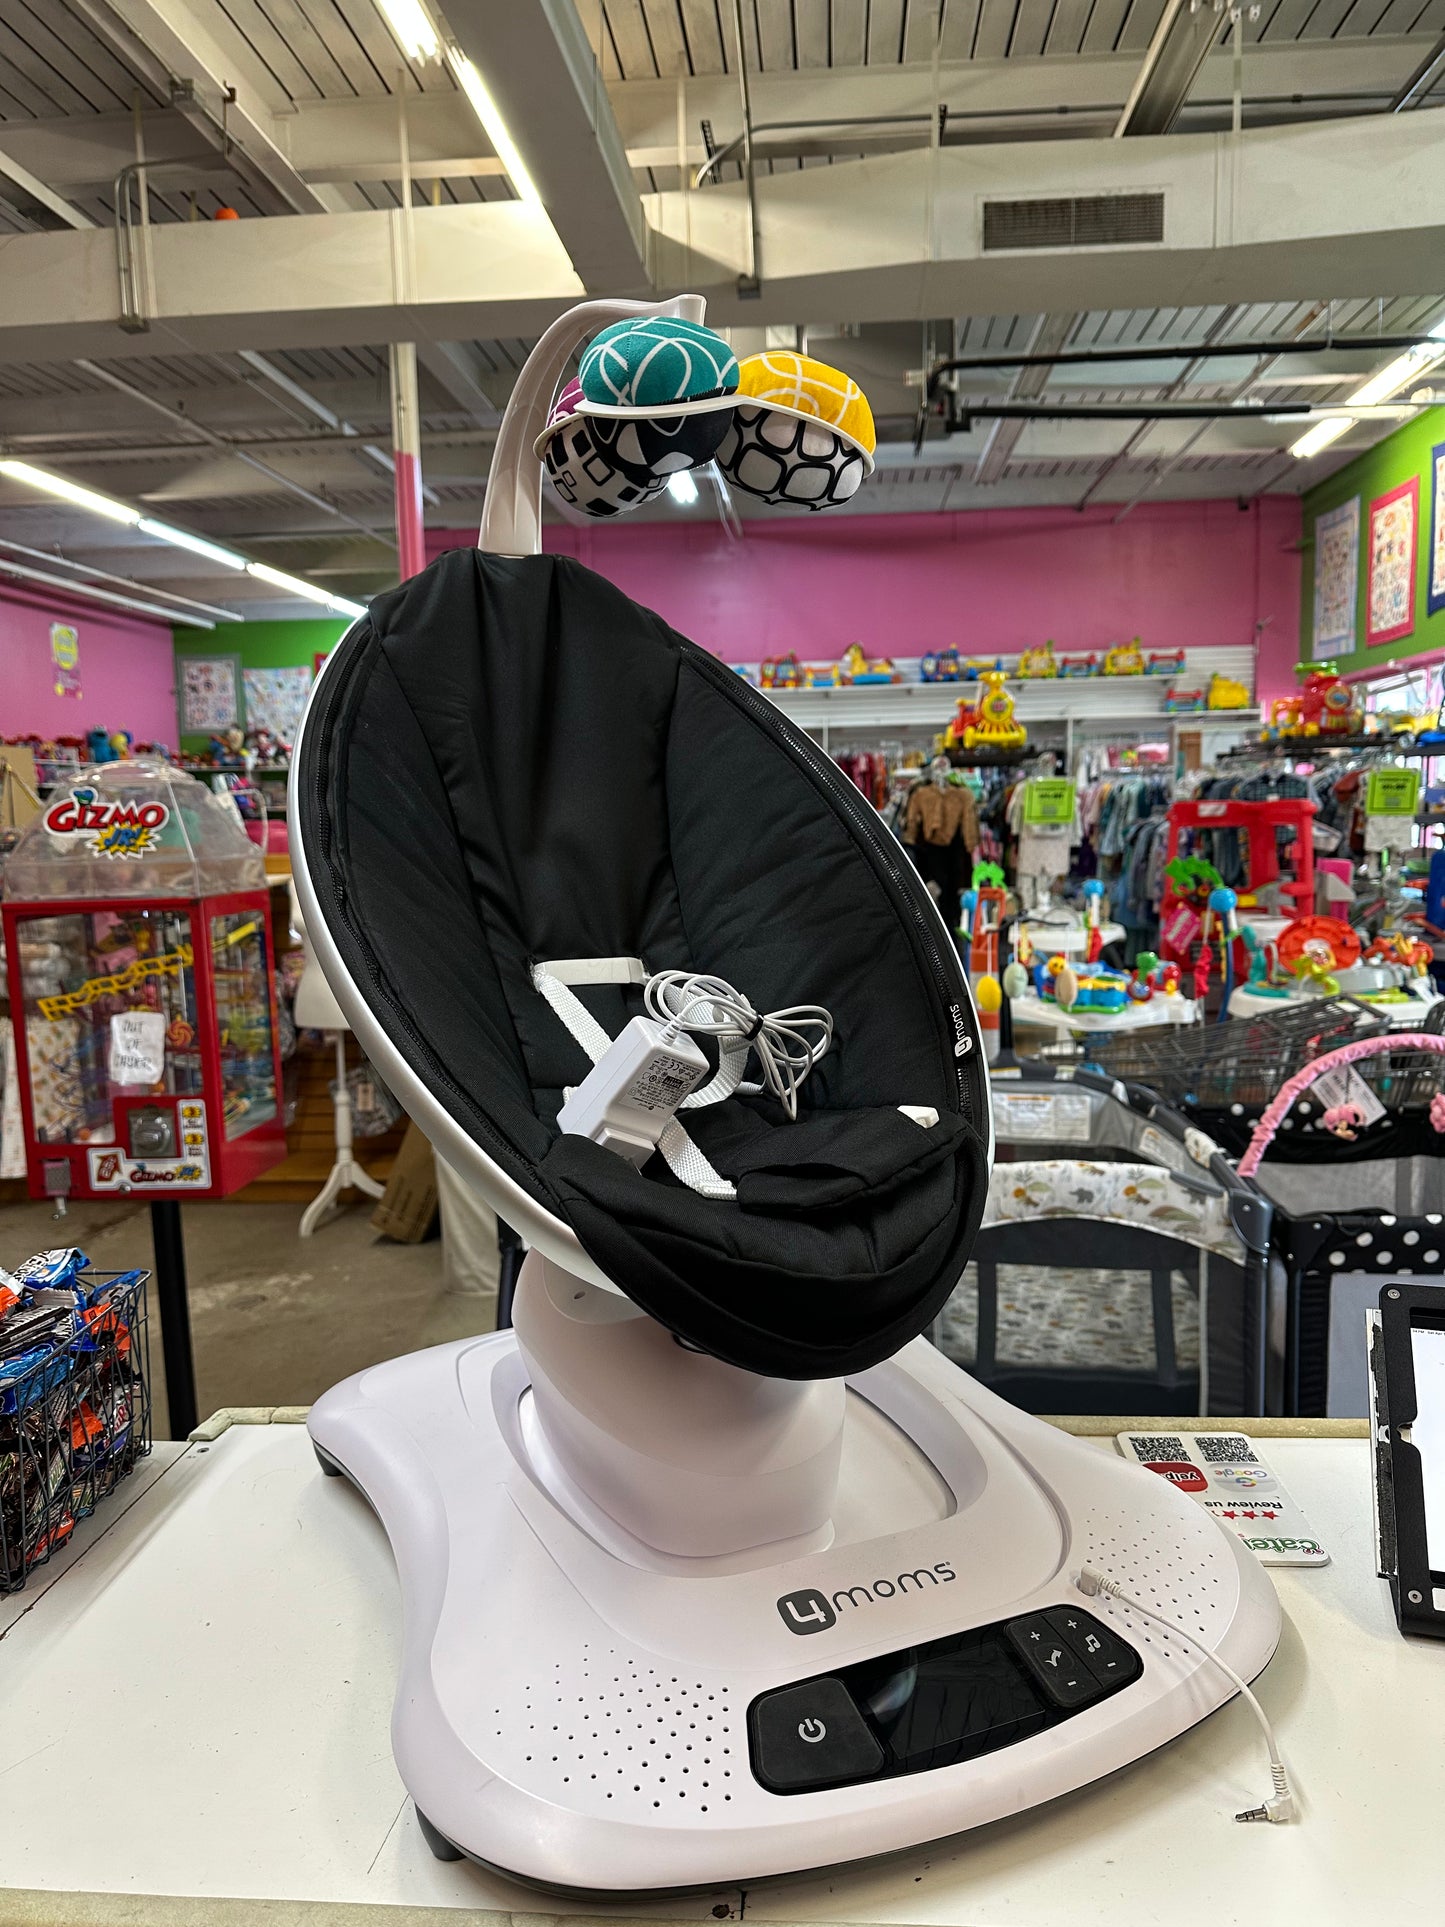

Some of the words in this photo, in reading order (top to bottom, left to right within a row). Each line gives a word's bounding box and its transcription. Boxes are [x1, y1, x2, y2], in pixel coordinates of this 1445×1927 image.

[949, 1004, 973, 1057] 4moms
[1214, 1468, 1267, 1478] Google
[1227, 1501, 1283, 1509] Review
[777, 1561, 957, 1635] 4moms
